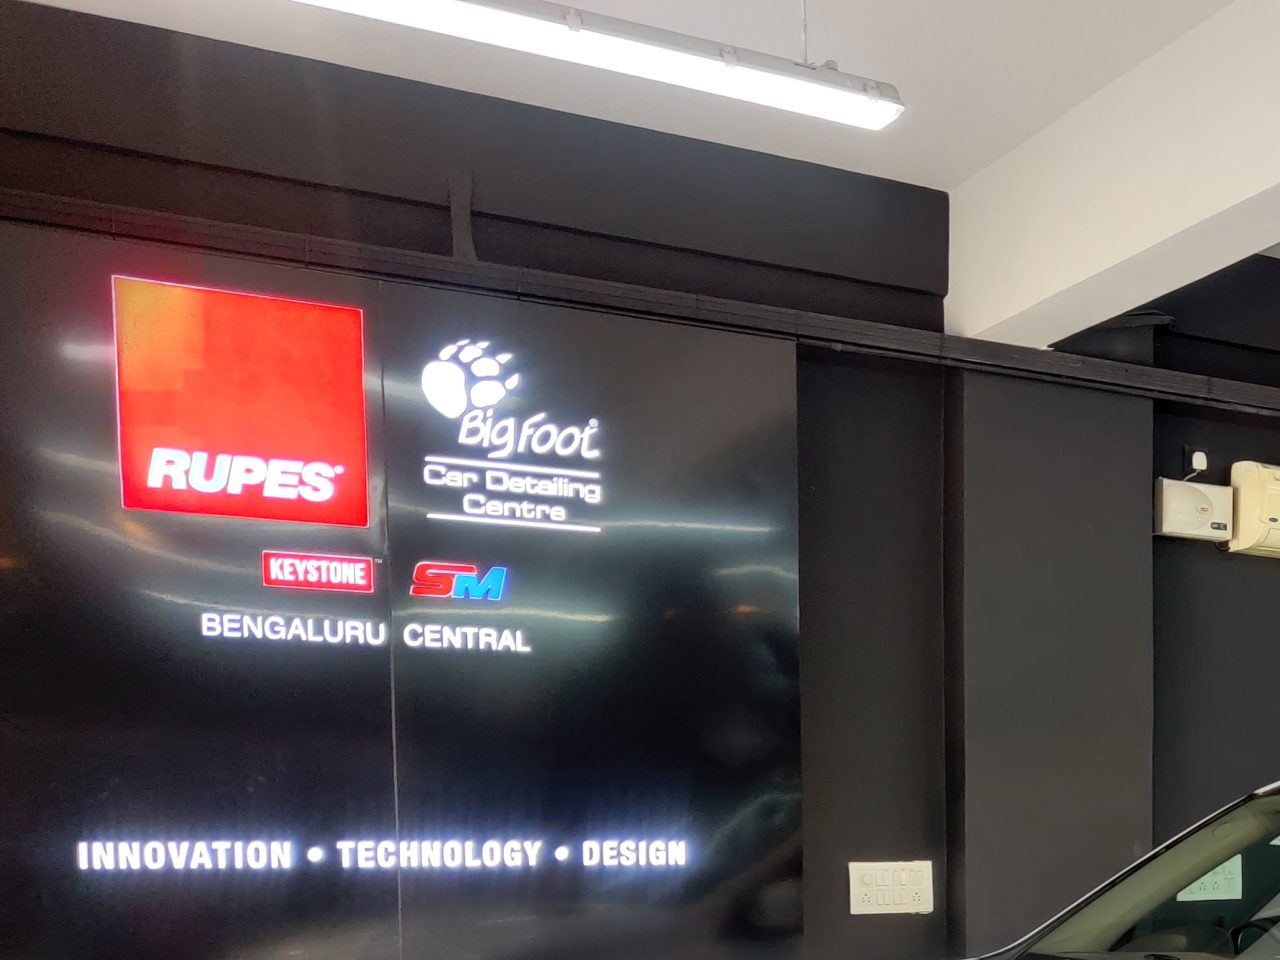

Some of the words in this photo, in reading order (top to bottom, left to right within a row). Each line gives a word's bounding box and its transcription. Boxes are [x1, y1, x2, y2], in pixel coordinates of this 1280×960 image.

[147, 447, 336, 502] RUPES
[423, 464, 479, 488] Car
[485, 470, 601, 504] Detailing
[463, 493, 566, 521] Centre
[269, 557, 367, 585] KEYSTONE
[410, 561, 507, 601] SM
[201, 613, 386, 646] BENGALURU
[403, 623, 532, 652] CENTRAL
[78, 841, 291, 870] INNOVATION
[336, 840, 542, 868] TECHNOLOGY
[582, 840, 686, 866] DESIGN
